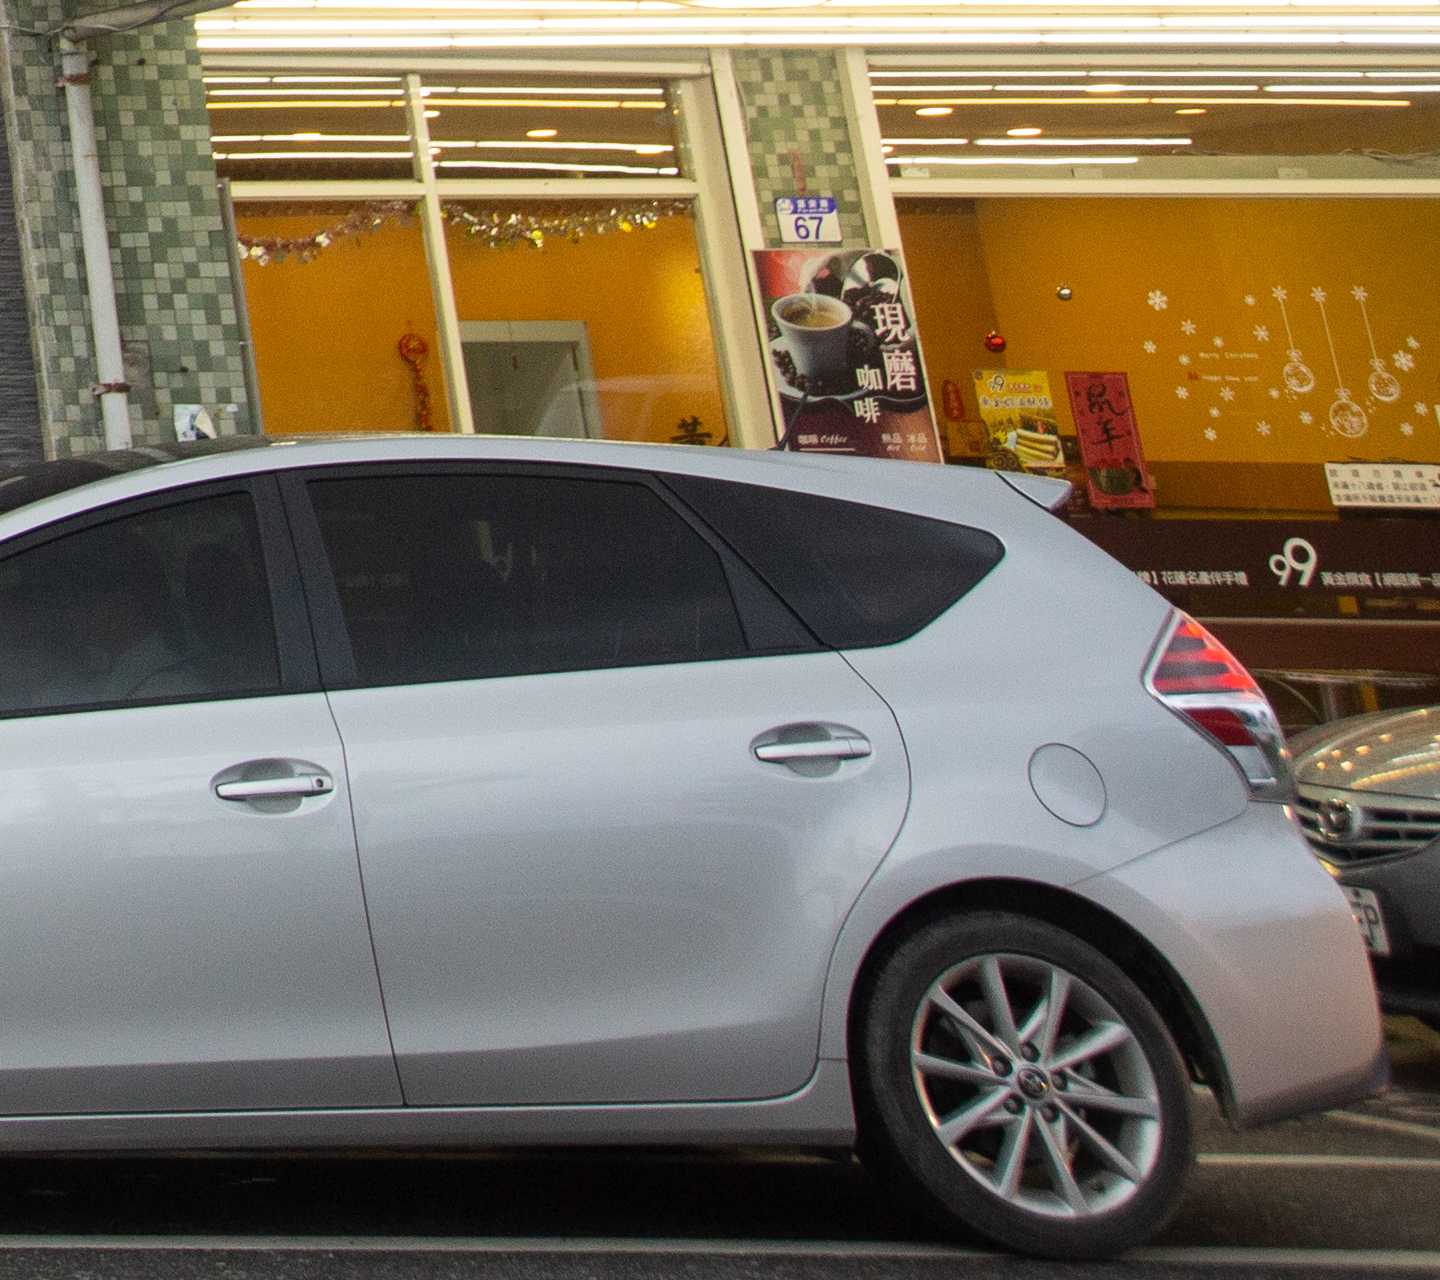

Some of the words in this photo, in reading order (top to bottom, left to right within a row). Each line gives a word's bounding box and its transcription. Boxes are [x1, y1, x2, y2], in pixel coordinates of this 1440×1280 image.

[794, 216, 823, 239] 67
[854, 364, 884, 424] 咖啡
[1269, 537, 1317, 587] 99
